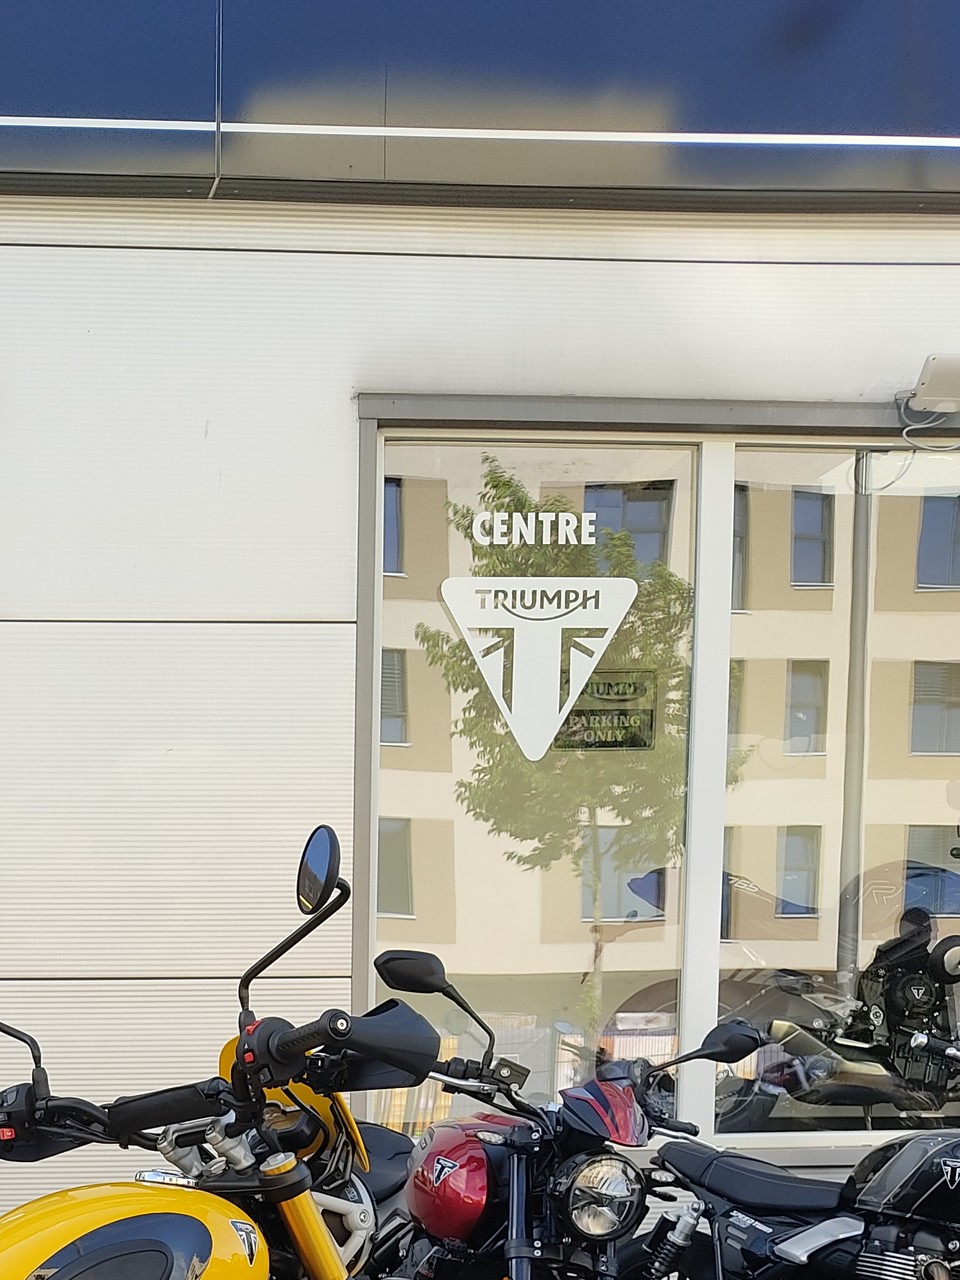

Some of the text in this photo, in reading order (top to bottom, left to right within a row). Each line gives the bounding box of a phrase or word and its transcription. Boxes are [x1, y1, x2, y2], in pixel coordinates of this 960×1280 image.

[472, 512, 597, 546] CENTRE
[475, 589, 600, 621] TRIUMPH
[569, 715, 641, 727] PARKING
[583, 730, 626, 742] ONLY
